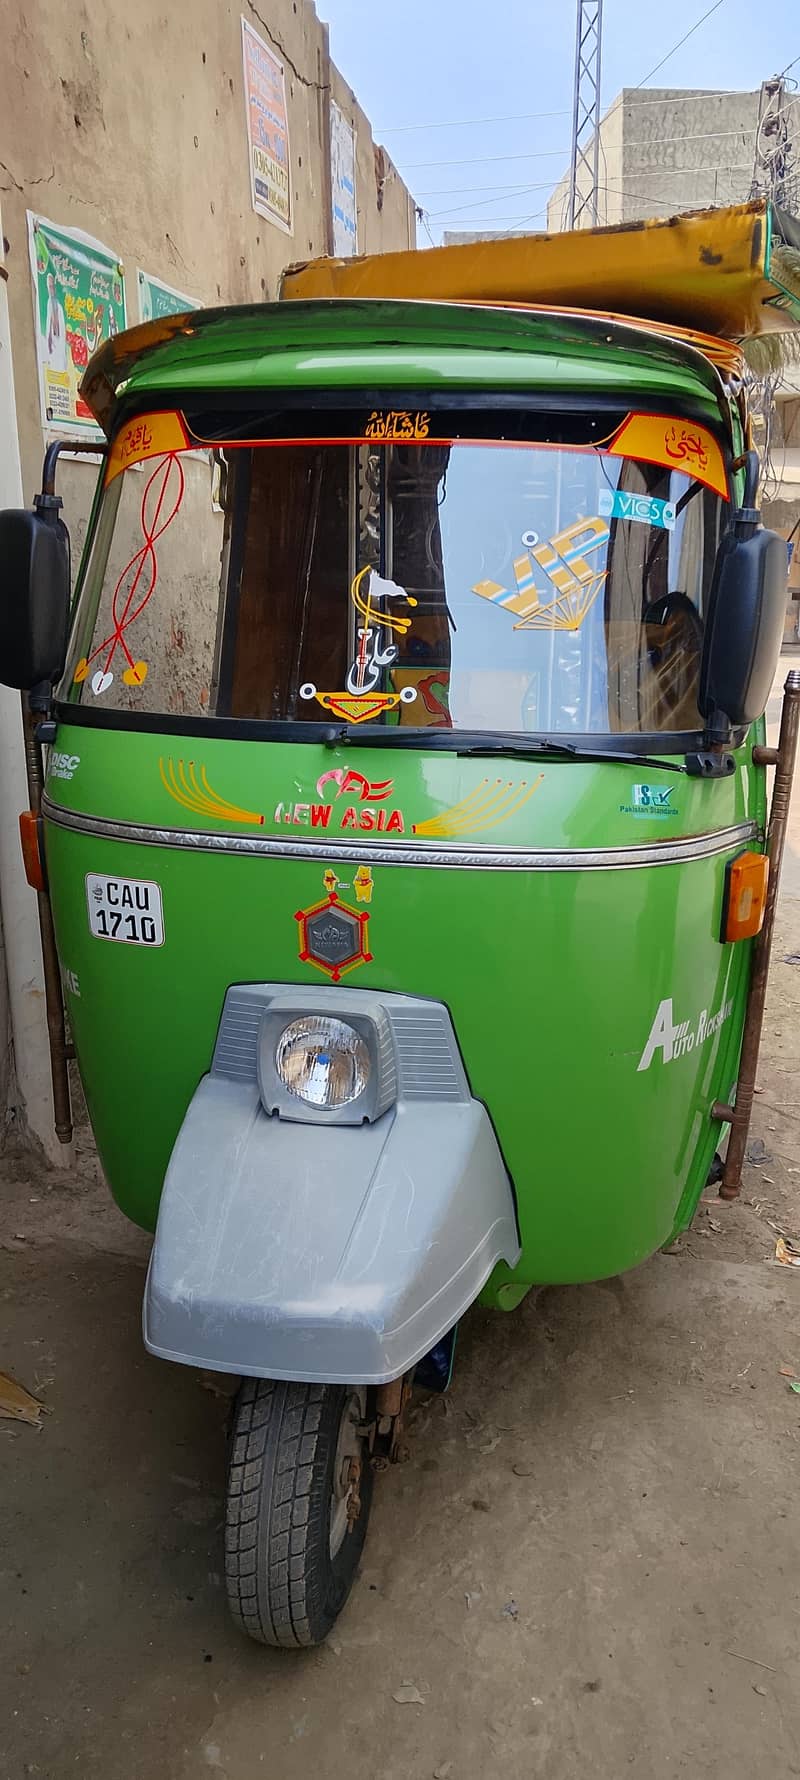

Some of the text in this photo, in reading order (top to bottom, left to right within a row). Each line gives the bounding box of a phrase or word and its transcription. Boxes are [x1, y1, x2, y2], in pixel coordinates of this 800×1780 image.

[618, 496, 660, 520] VICS
[470, 516, 610, 619] VIP
[274, 802, 405, 833] NEW ASIA
[107, 882, 149, 911] CAU
[96, 909, 156, 942] 1710
